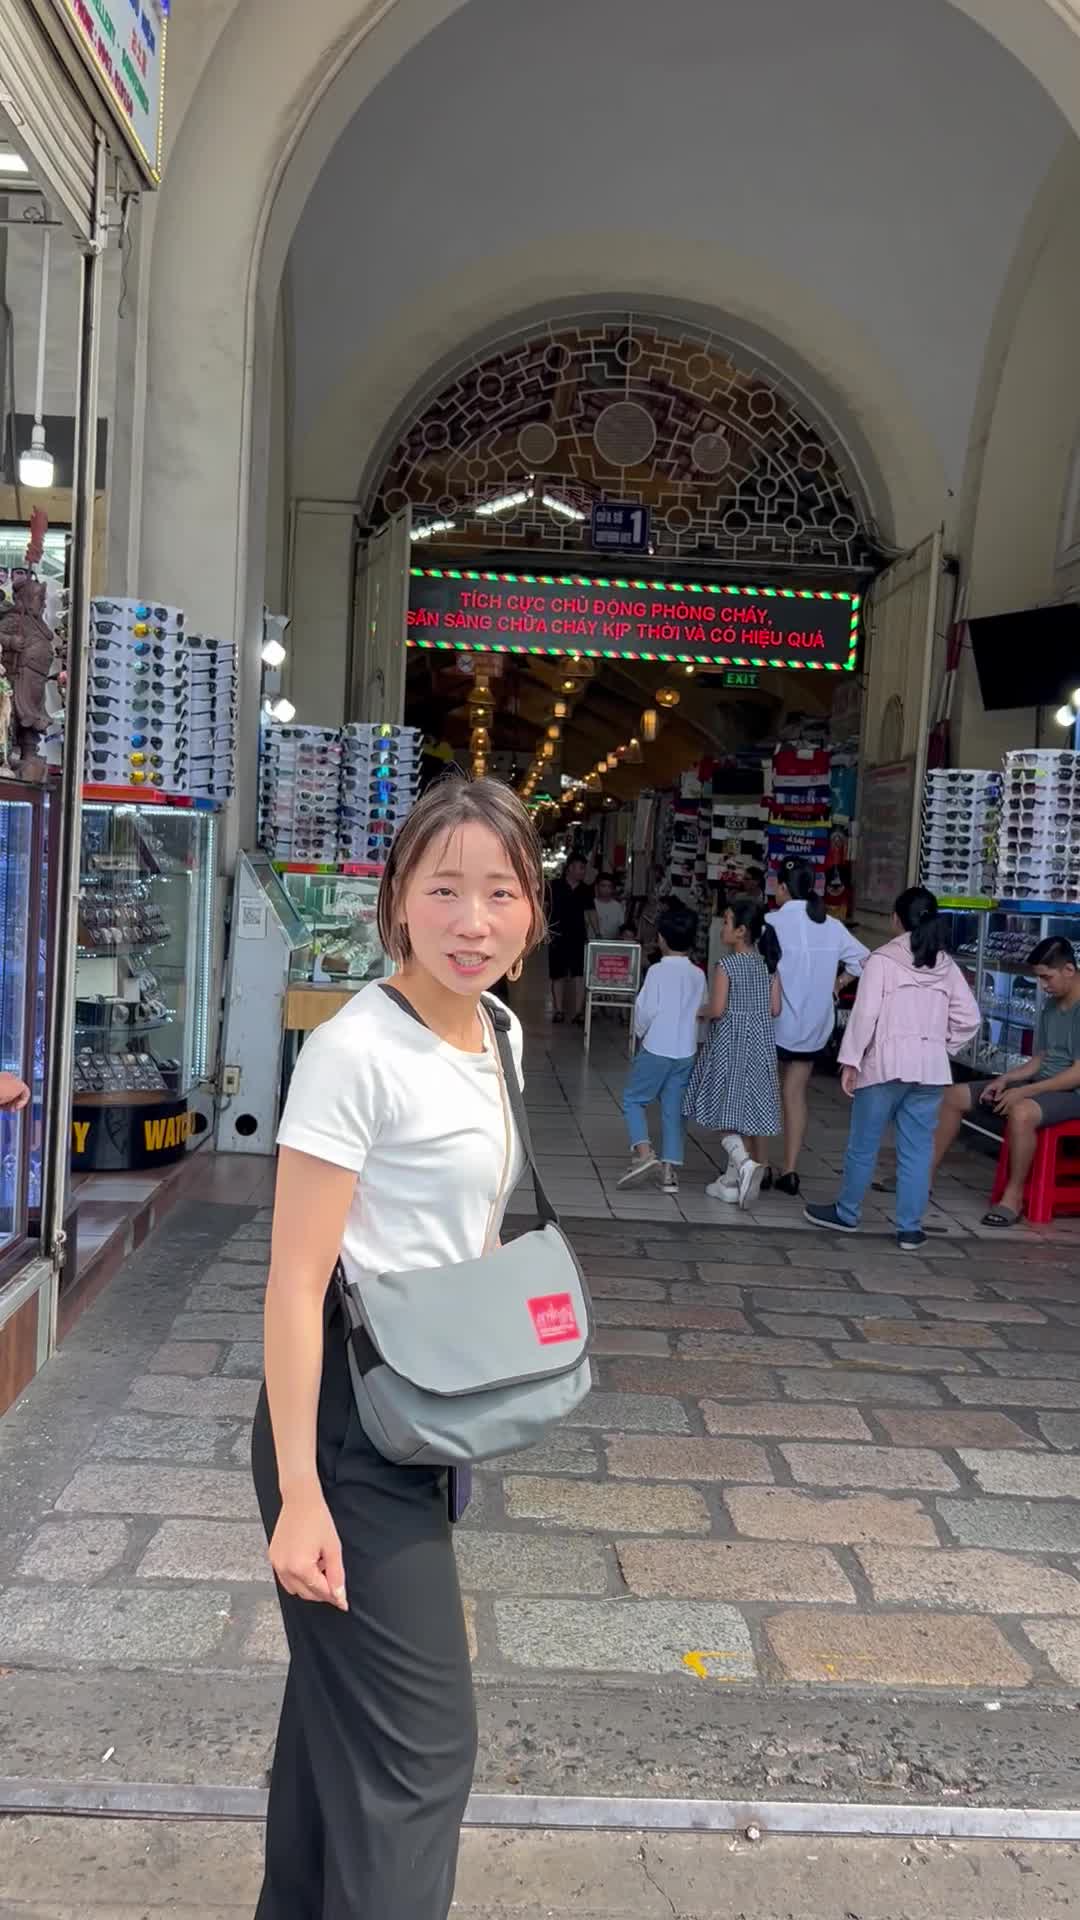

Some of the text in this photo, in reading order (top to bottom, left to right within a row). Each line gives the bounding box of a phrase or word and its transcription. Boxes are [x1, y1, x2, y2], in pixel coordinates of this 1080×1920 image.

[630, 510, 642, 544] 1
[460, 589, 773, 626] TÍCH CỰC CHỦ ĐỘNG PHÒNG CHÁY,
[443, 611, 492, 630] SÀNG
[497, 611, 548, 633] CHỮA
[551, 617, 598, 637] CHÁY
[603, 621, 631, 640] KỊP
[637, 621, 680, 641] THỜI
[684, 624, 706, 641] VÀ
[710, 625, 736, 644] CÓ
[742, 628, 782, 648] HIỆU
[726, 672, 757, 686] EXIT
